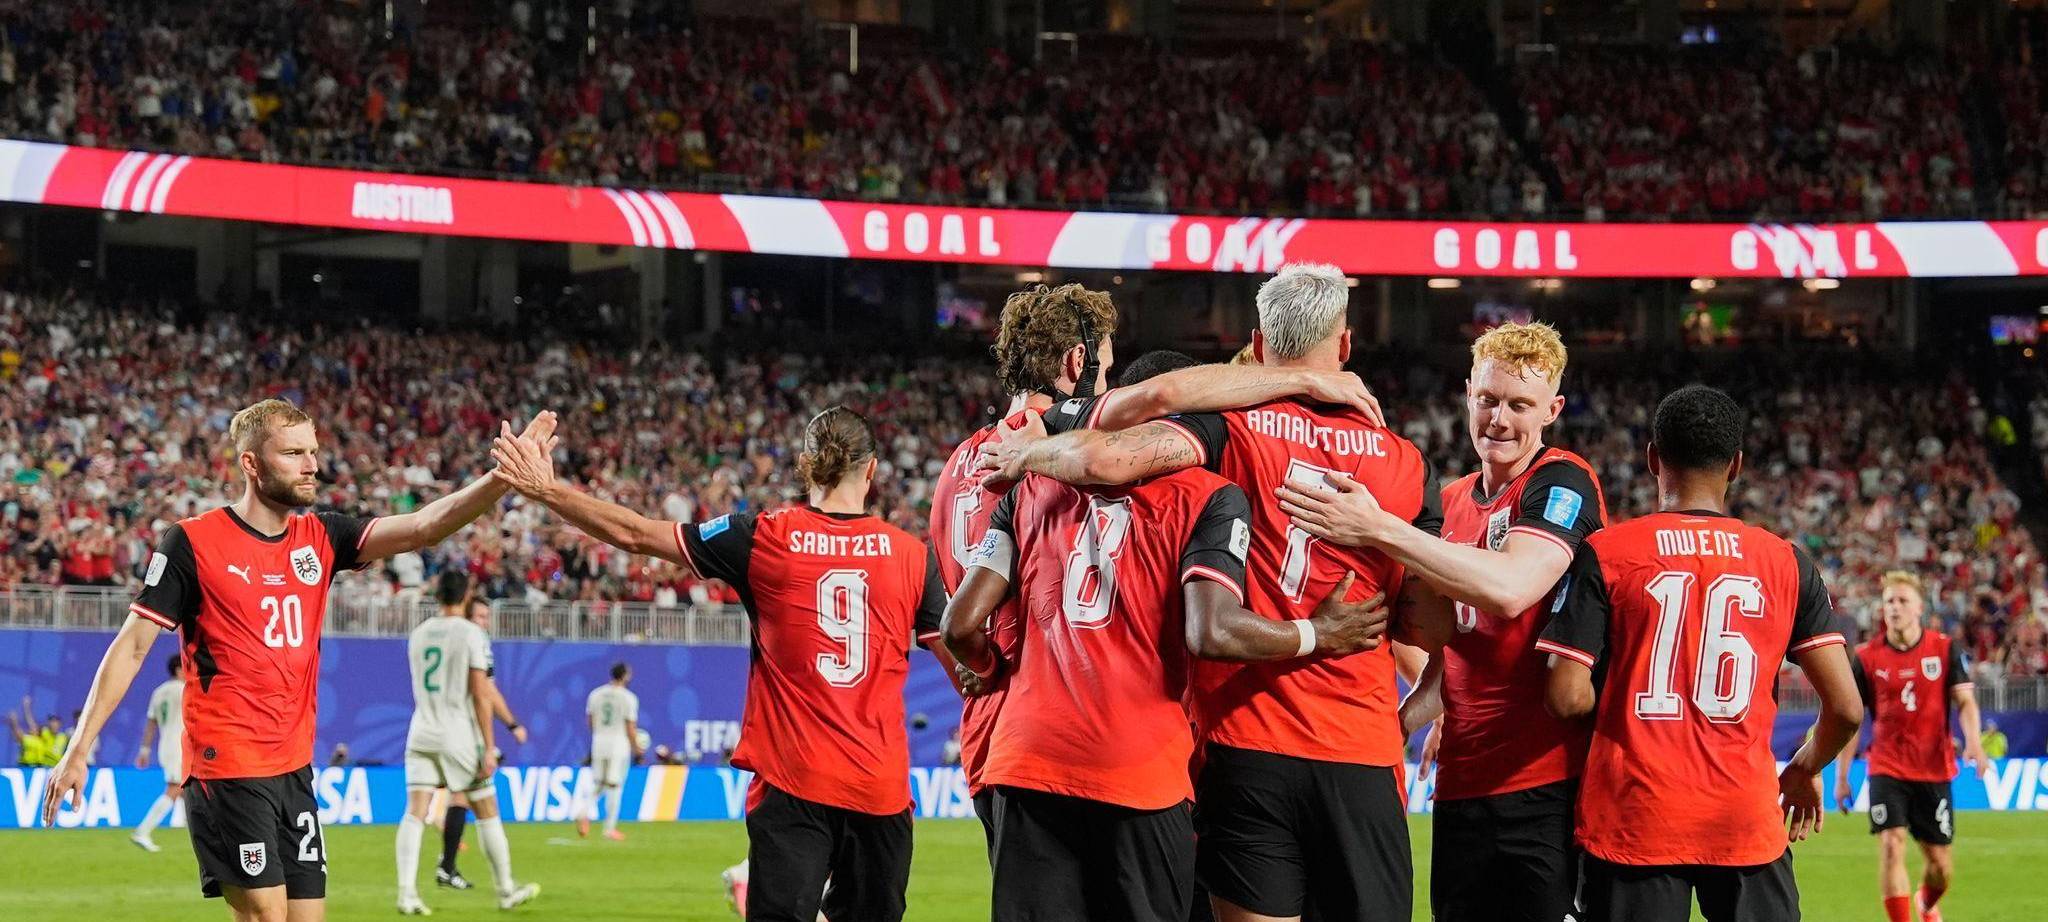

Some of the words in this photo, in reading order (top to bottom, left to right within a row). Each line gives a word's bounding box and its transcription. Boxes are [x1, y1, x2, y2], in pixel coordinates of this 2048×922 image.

[352, 182, 454, 224] AUSTRIA
[864, 210, 1000, 256] GOAL
[1433, 228, 1577, 269] GOAL
[1731, 230, 1878, 270] GOAL
[1247, 410, 1386, 457] ARNAUTOVIC
[789, 530, 892, 556] SABITZER
[1063, 494, 1133, 629] 8
[1655, 529, 1743, 559] MWENE
[261, 594, 303, 648] 20
[816, 568, 869, 688] 9
[424, 647, 442, 692] 2
[1635, 571, 1765, 724] 16
[1901, 681, 1917, 712] 4
[909, 766, 976, 818] VIS
[1934, 798, 1952, 839] 4
[296, 811, 328, 875] 2
